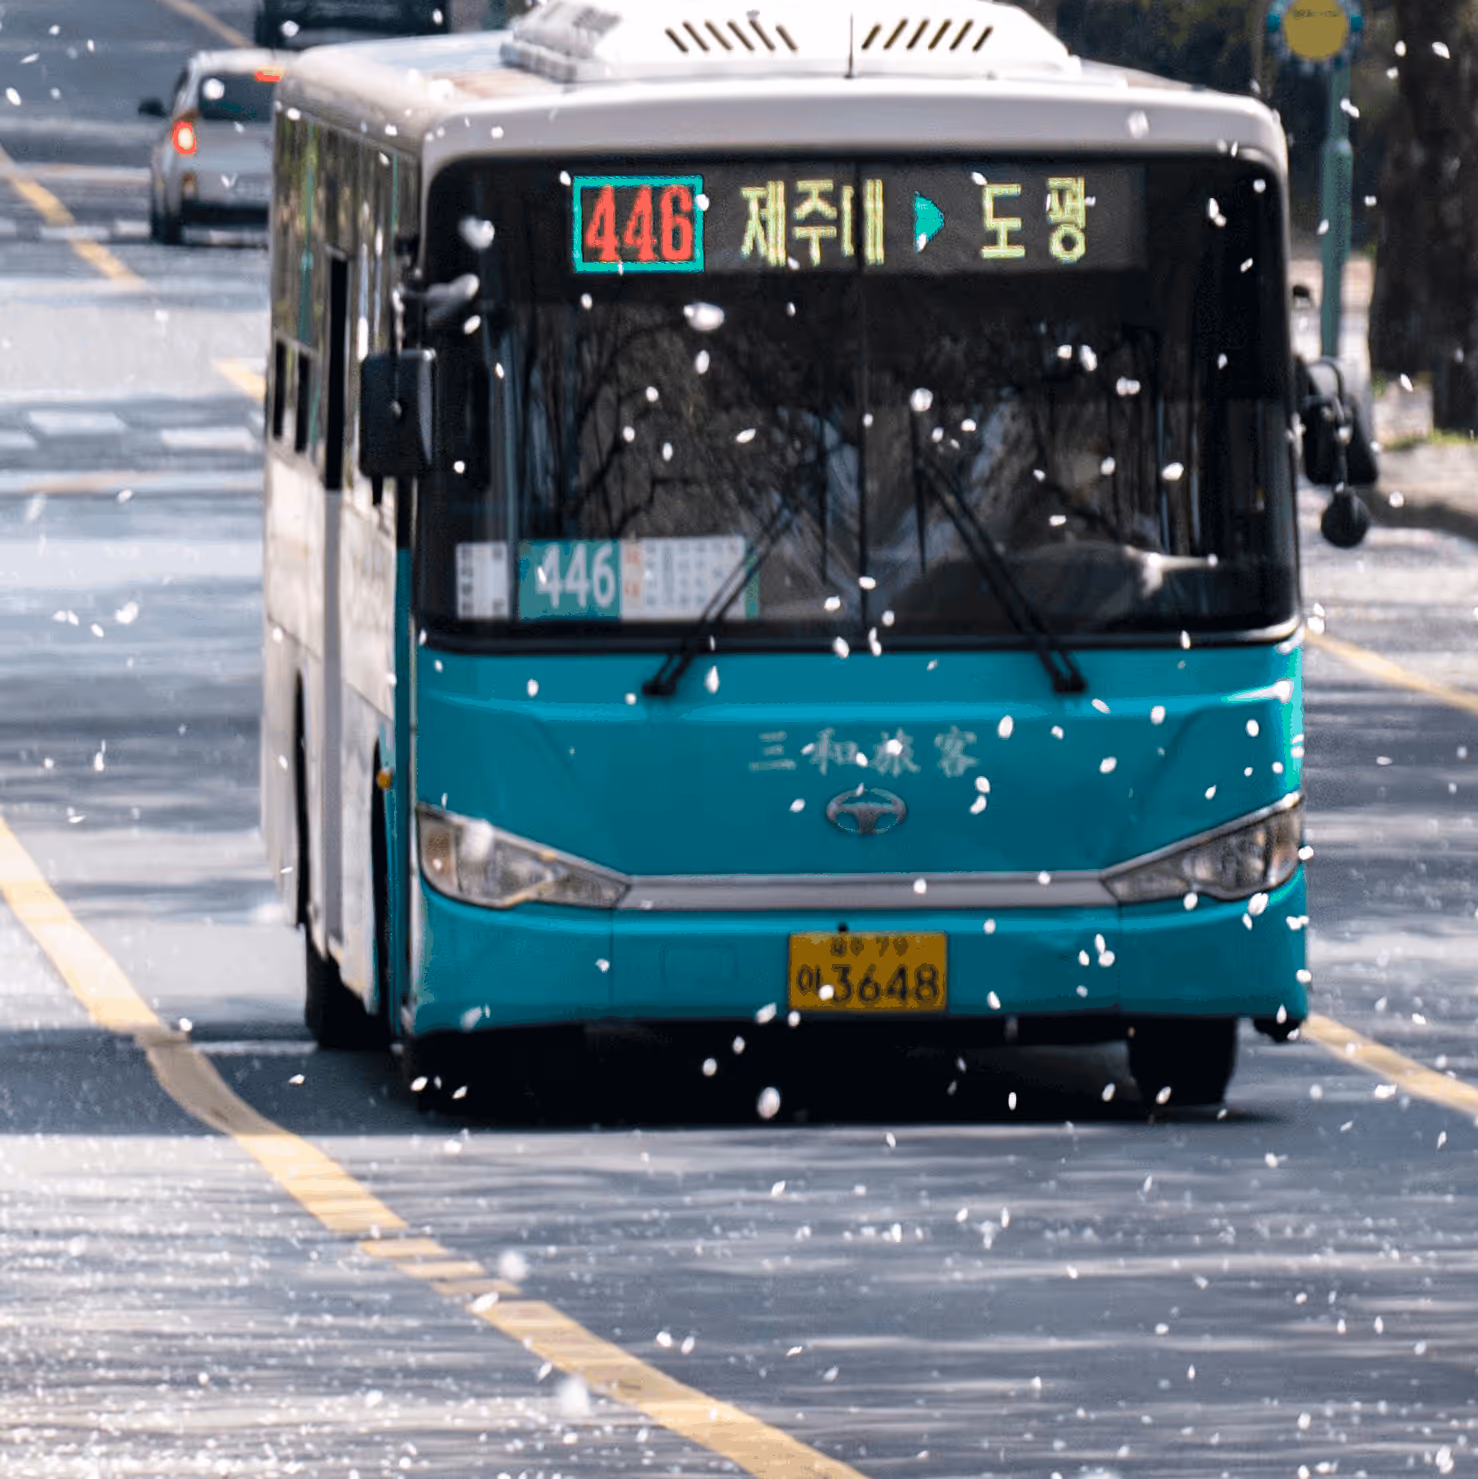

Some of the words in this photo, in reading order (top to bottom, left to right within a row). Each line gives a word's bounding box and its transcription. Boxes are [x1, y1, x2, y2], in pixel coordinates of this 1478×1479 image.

[585, 184, 692, 261] 446
[740, 178, 885, 266] 제주대
[535, 543, 616, 609] 446
